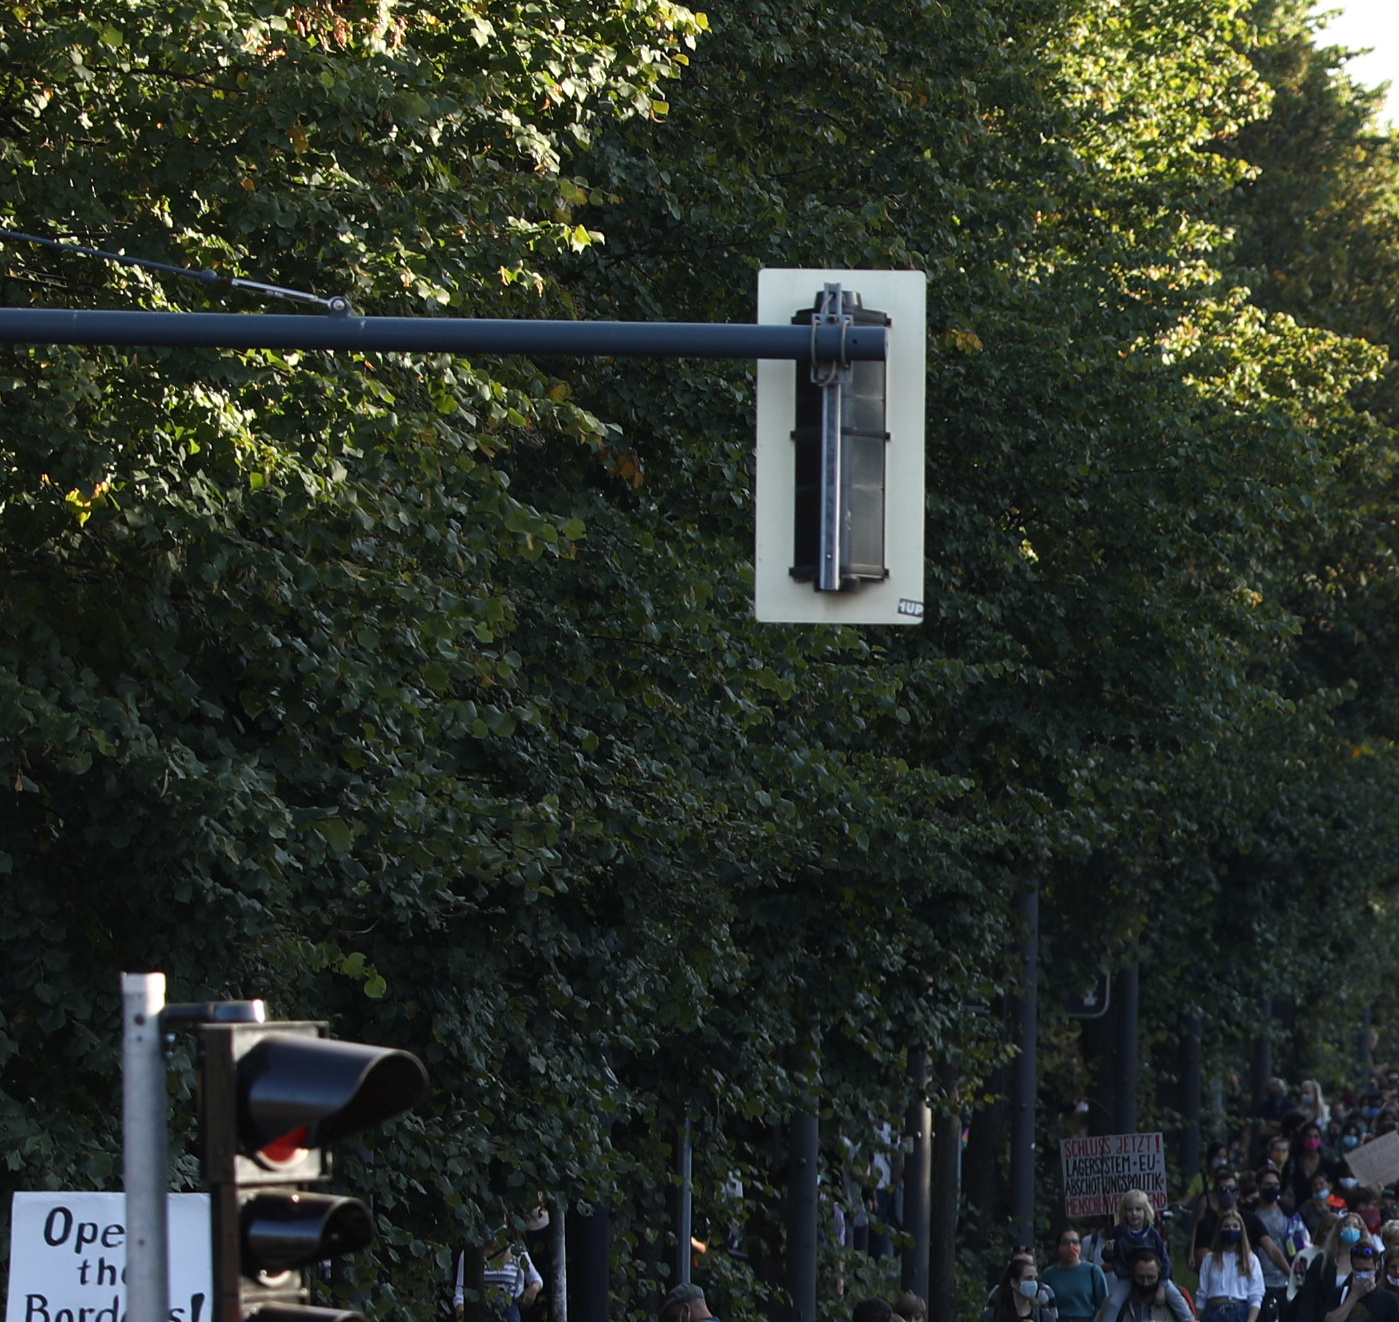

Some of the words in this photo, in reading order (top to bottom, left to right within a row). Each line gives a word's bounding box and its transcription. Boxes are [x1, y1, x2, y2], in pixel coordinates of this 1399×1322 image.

[1064, 1137, 1112, 1158] SCHLUSS
[44, 1206, 126, 1254] Ope
[77, 1257, 127, 1286] th
